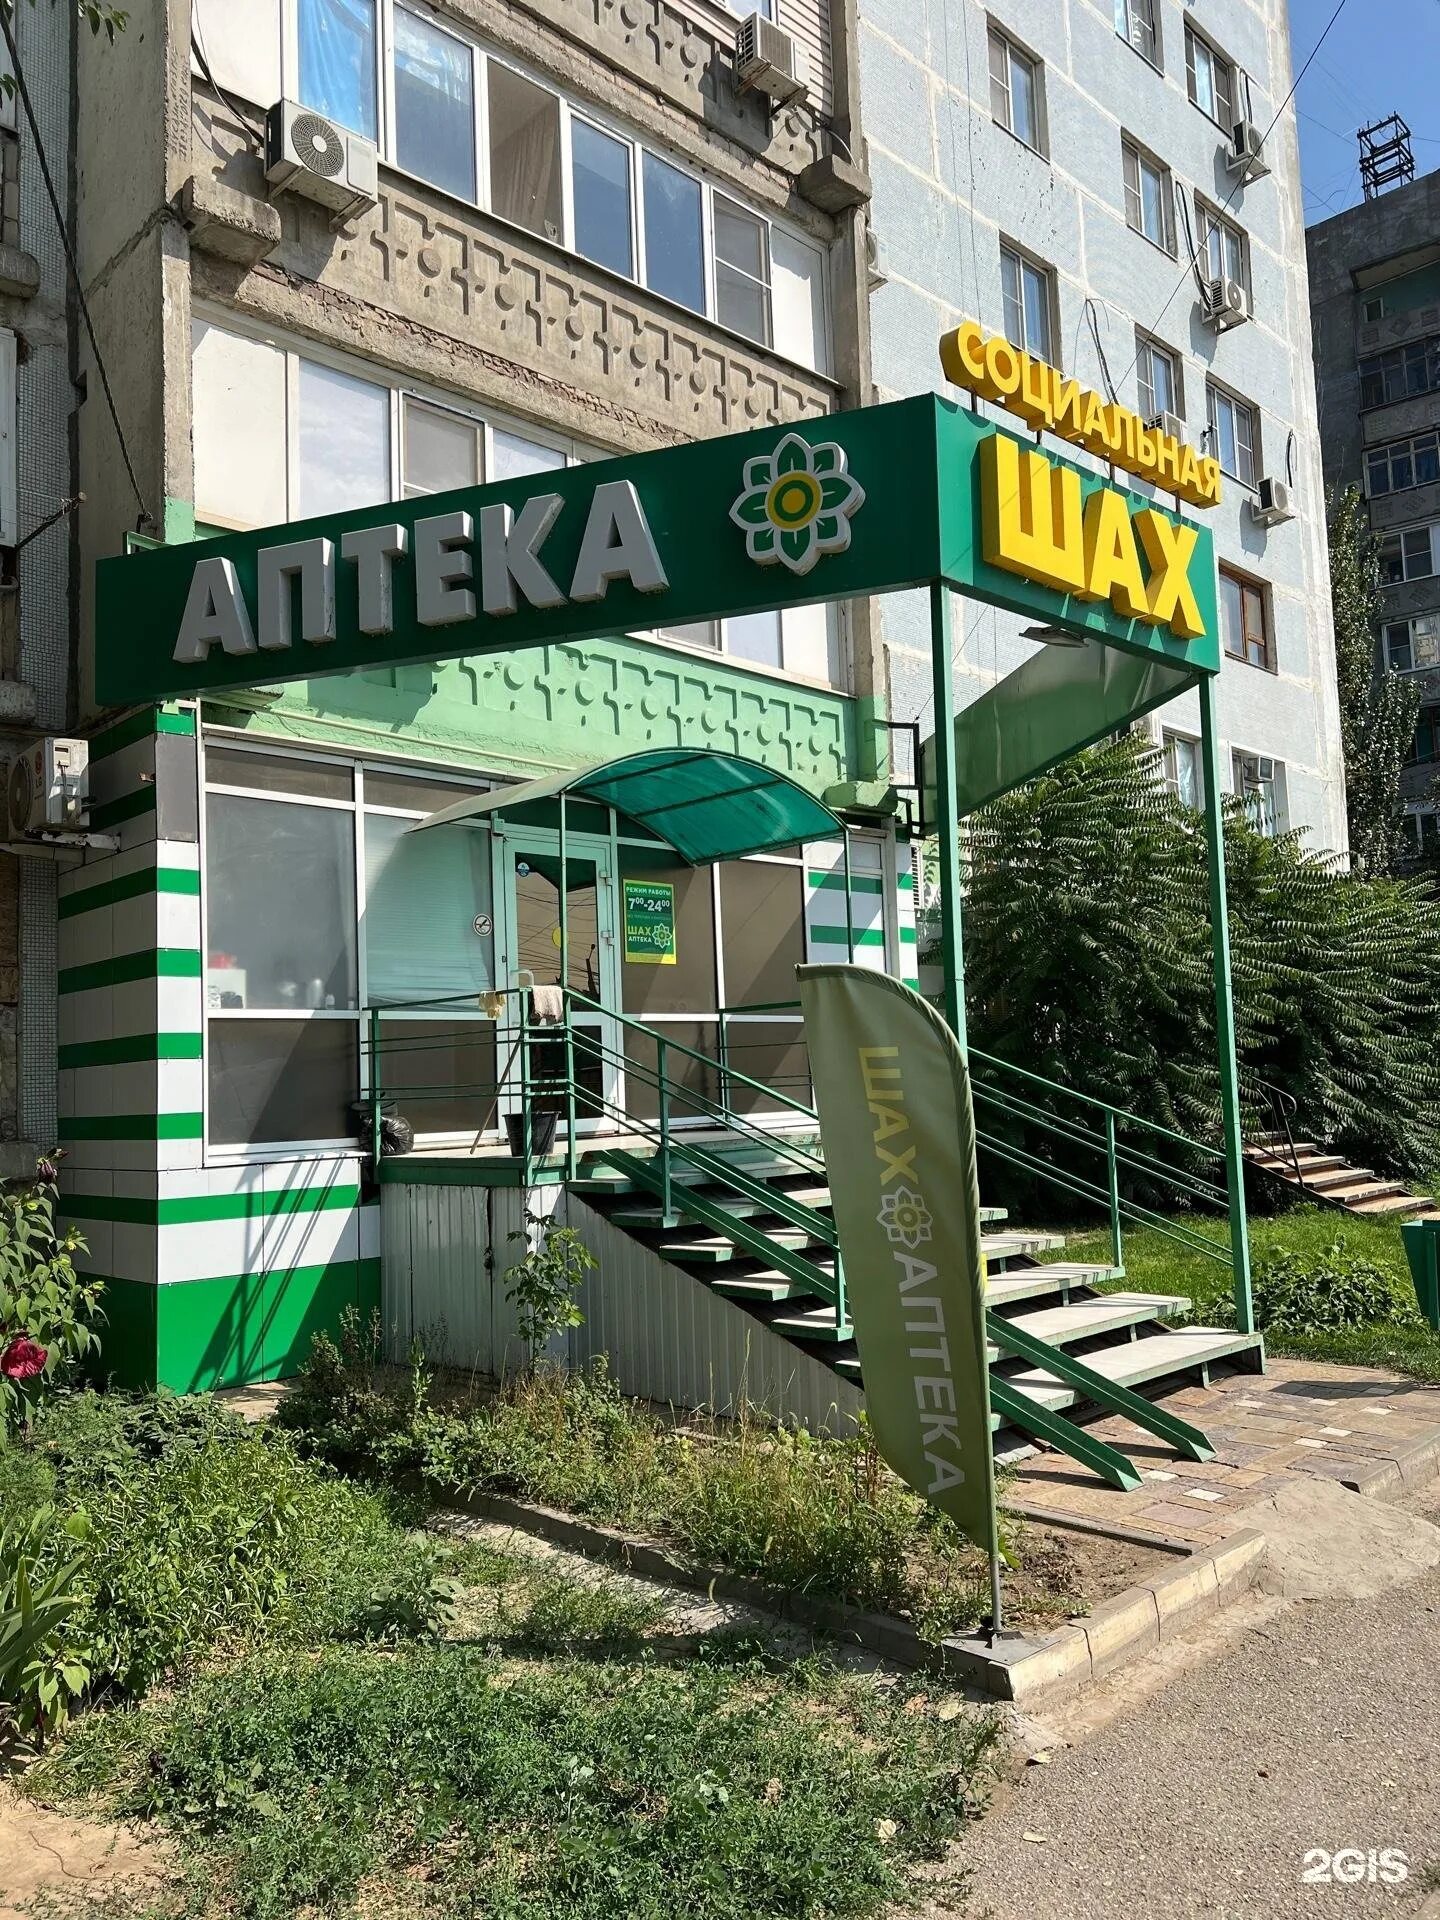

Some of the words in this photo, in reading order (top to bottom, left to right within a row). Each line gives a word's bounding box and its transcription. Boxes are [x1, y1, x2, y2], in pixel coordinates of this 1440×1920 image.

[947, 320, 1221, 507] СОЦИАЛЬНАЯ
[173, 480, 670, 664] АПТЕКА
[985, 433, 1208, 638] ШАХ
[626, 886, 647, 894] РЕЖИМ
[627, 925, 652, 936] ШАХ
[858, 1046, 918, 1186] ШАХ
[893, 1250, 966, 1495] АПТЕКА
